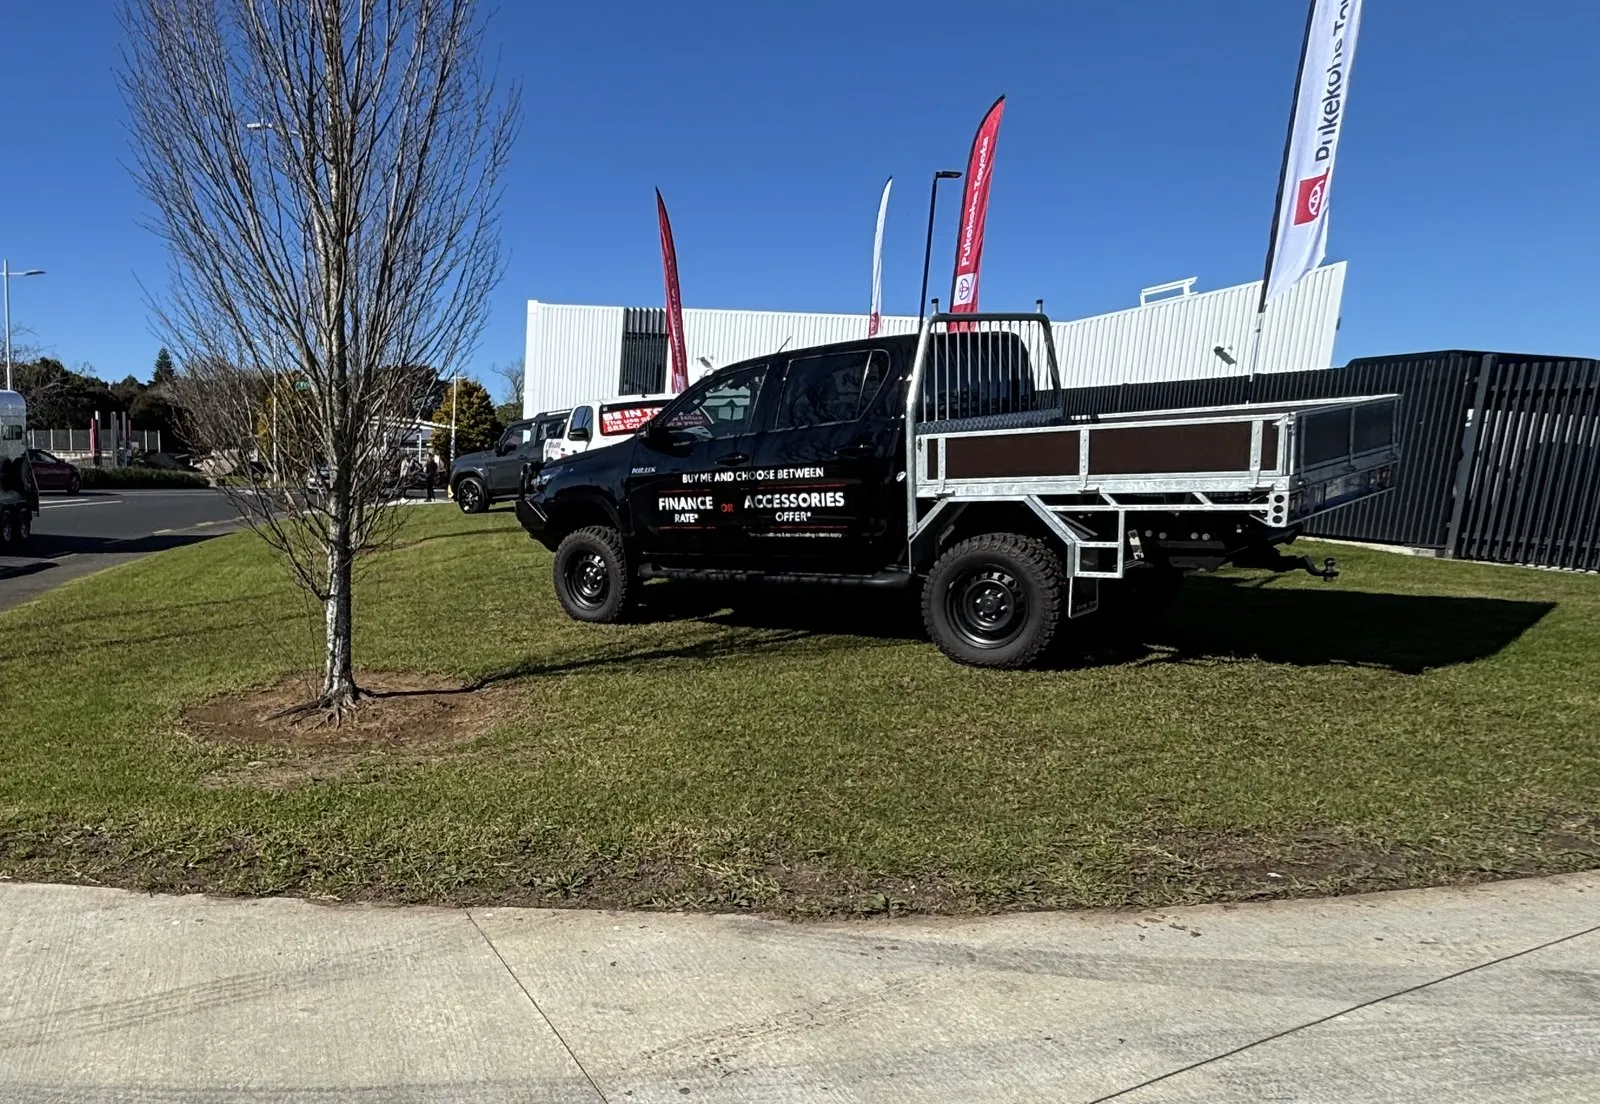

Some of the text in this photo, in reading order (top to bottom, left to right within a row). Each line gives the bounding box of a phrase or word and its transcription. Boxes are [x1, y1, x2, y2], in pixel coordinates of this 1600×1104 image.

[960, 136, 989, 267] Pukekohe Toyota
[602, 411, 623, 421] BE
[624, 408, 643, 418] IN
[682, 467, 824, 484] BUY ME AND CHOOSE BETWEEN
[658, 497, 713, 511] FINANCE
[721, 504, 734, 512] OR
[744, 492, 845, 509] ACCESSORIES
